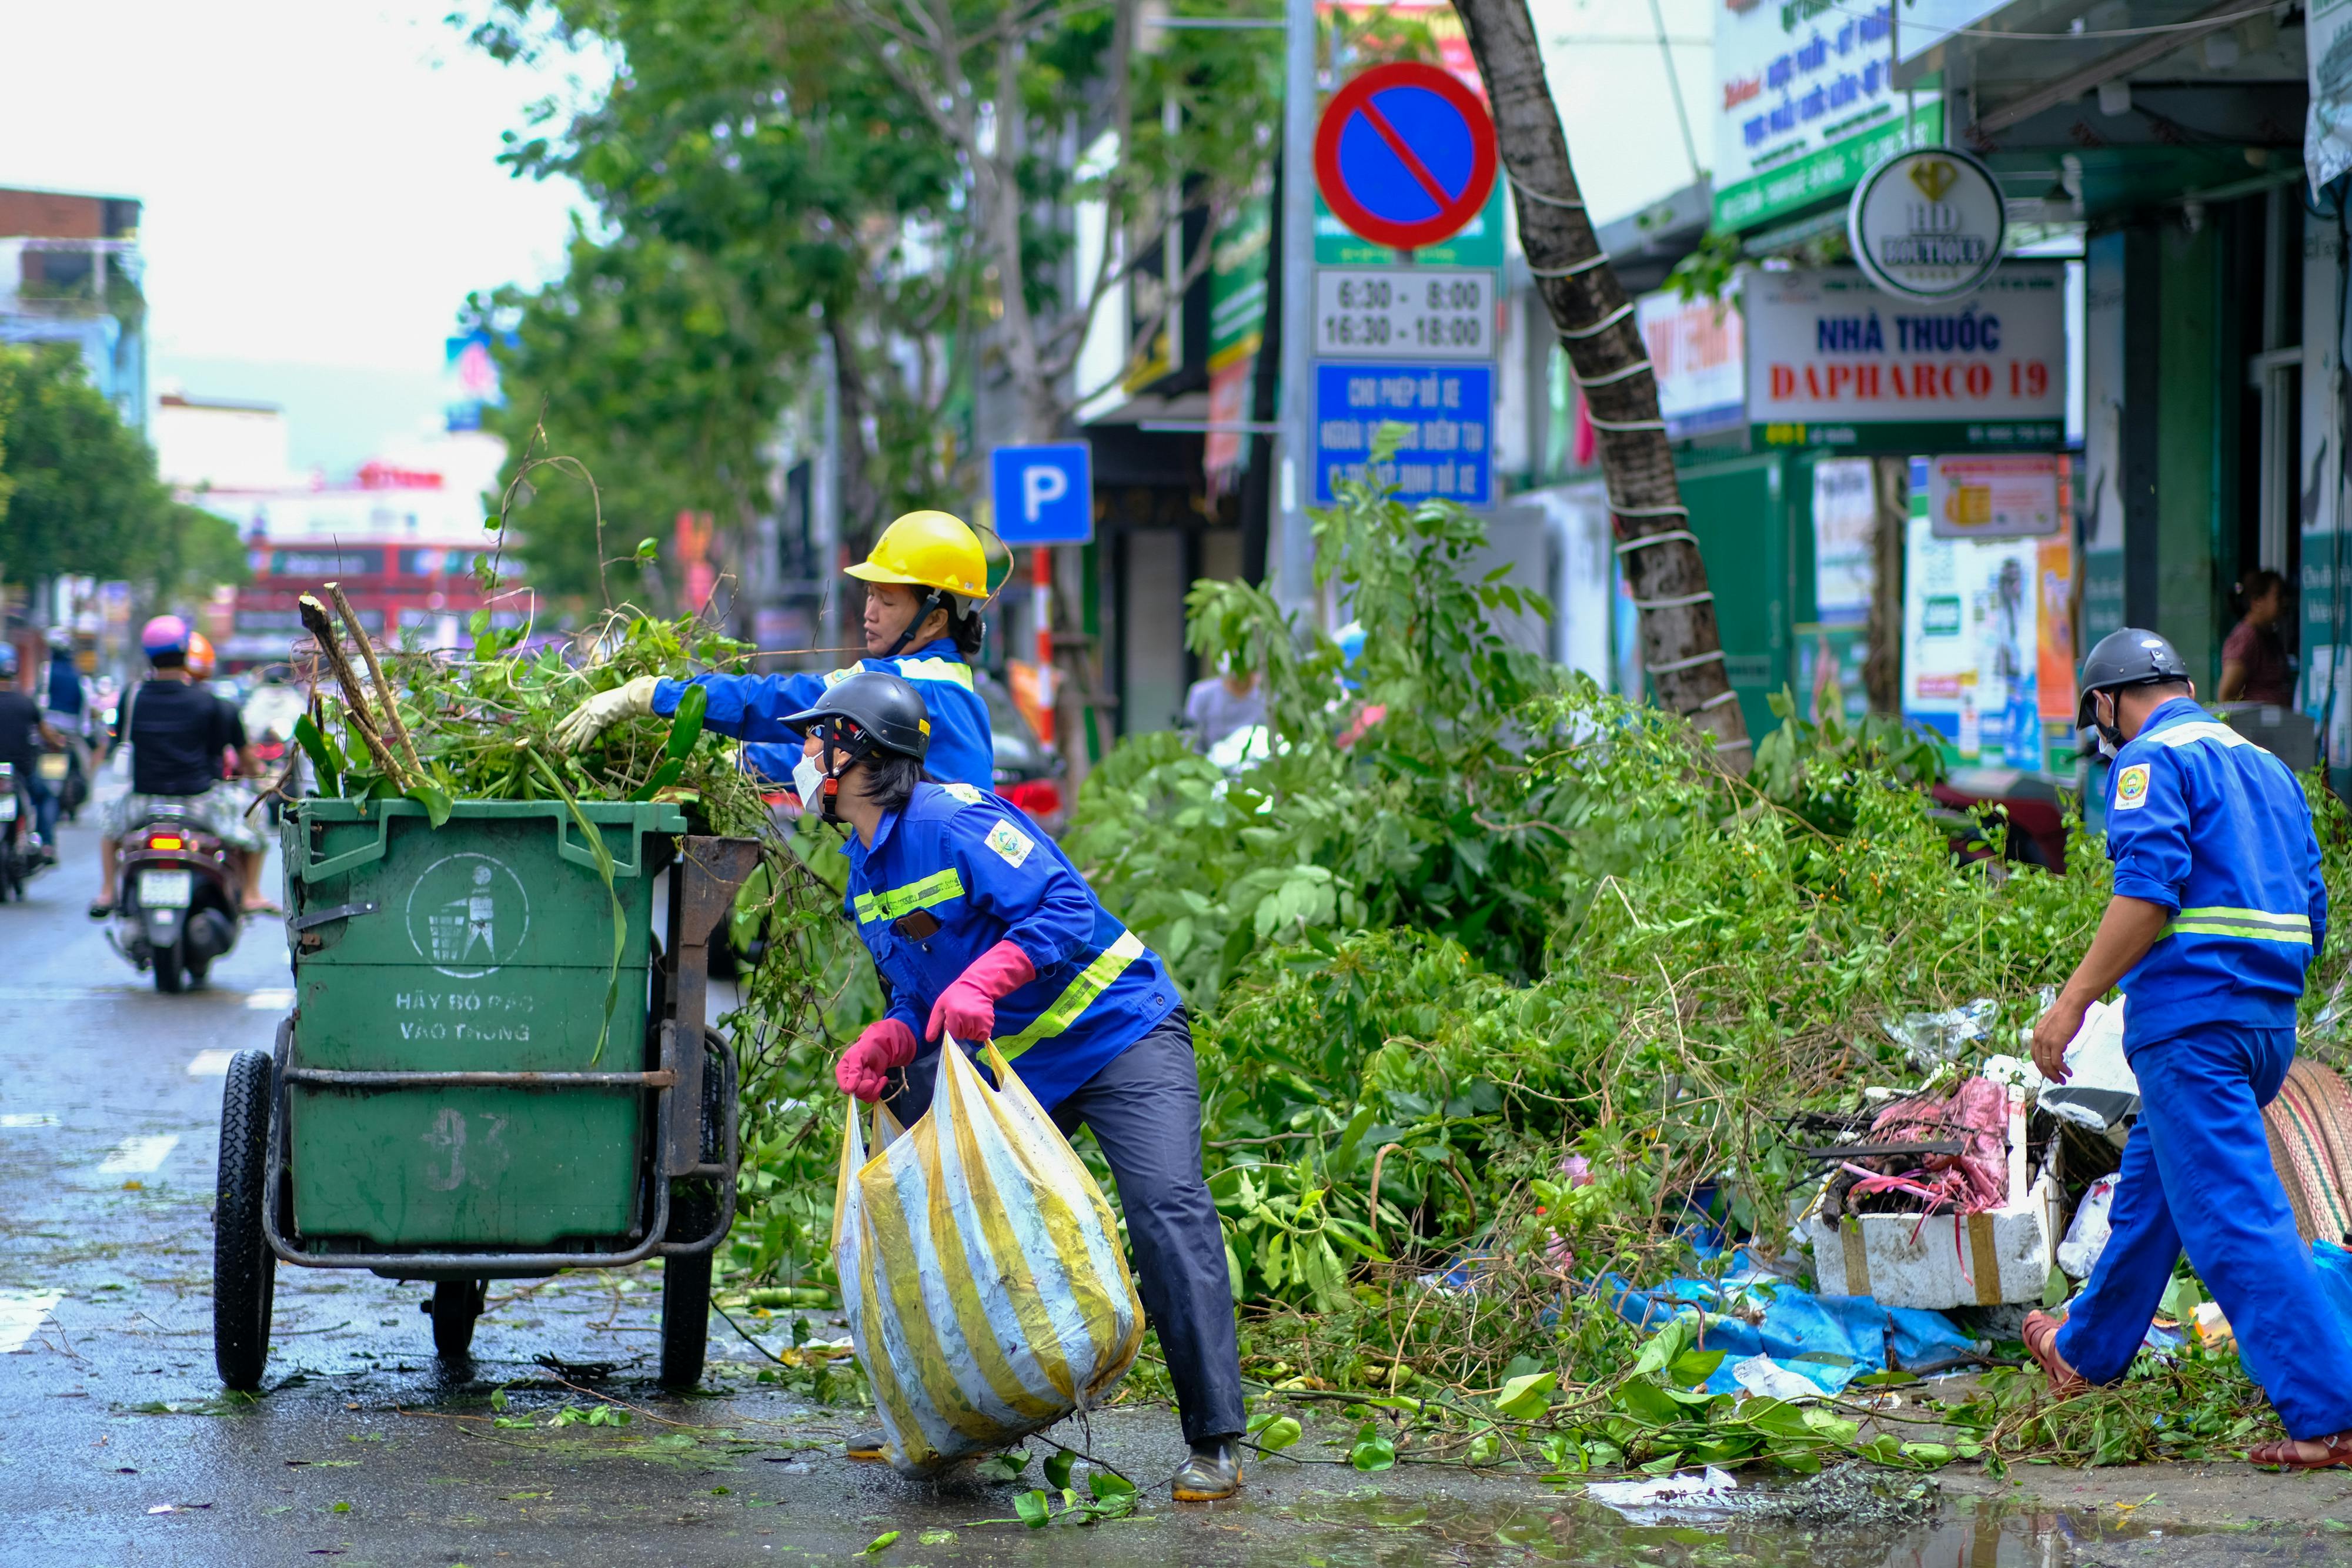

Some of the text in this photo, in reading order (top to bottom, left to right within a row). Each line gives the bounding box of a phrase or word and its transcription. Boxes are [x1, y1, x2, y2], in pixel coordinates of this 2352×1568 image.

[1907, 203, 1962, 236] HD
[1883, 236, 1985, 266] BOUTIQUE
[1338, 280, 1392, 309] 6:30
[1426, 281, 1481, 311] 8:00
[1326, 316, 1391, 345] 16:30
[1416, 316, 1481, 346] 18:00
[1817, 300, 2001, 353] NHÀ THUỐC
[1769, 360, 2049, 402] DAPHARCO 19
[1023, 464, 1068, 523] P
[396, 989, 441, 1010] HÃY
